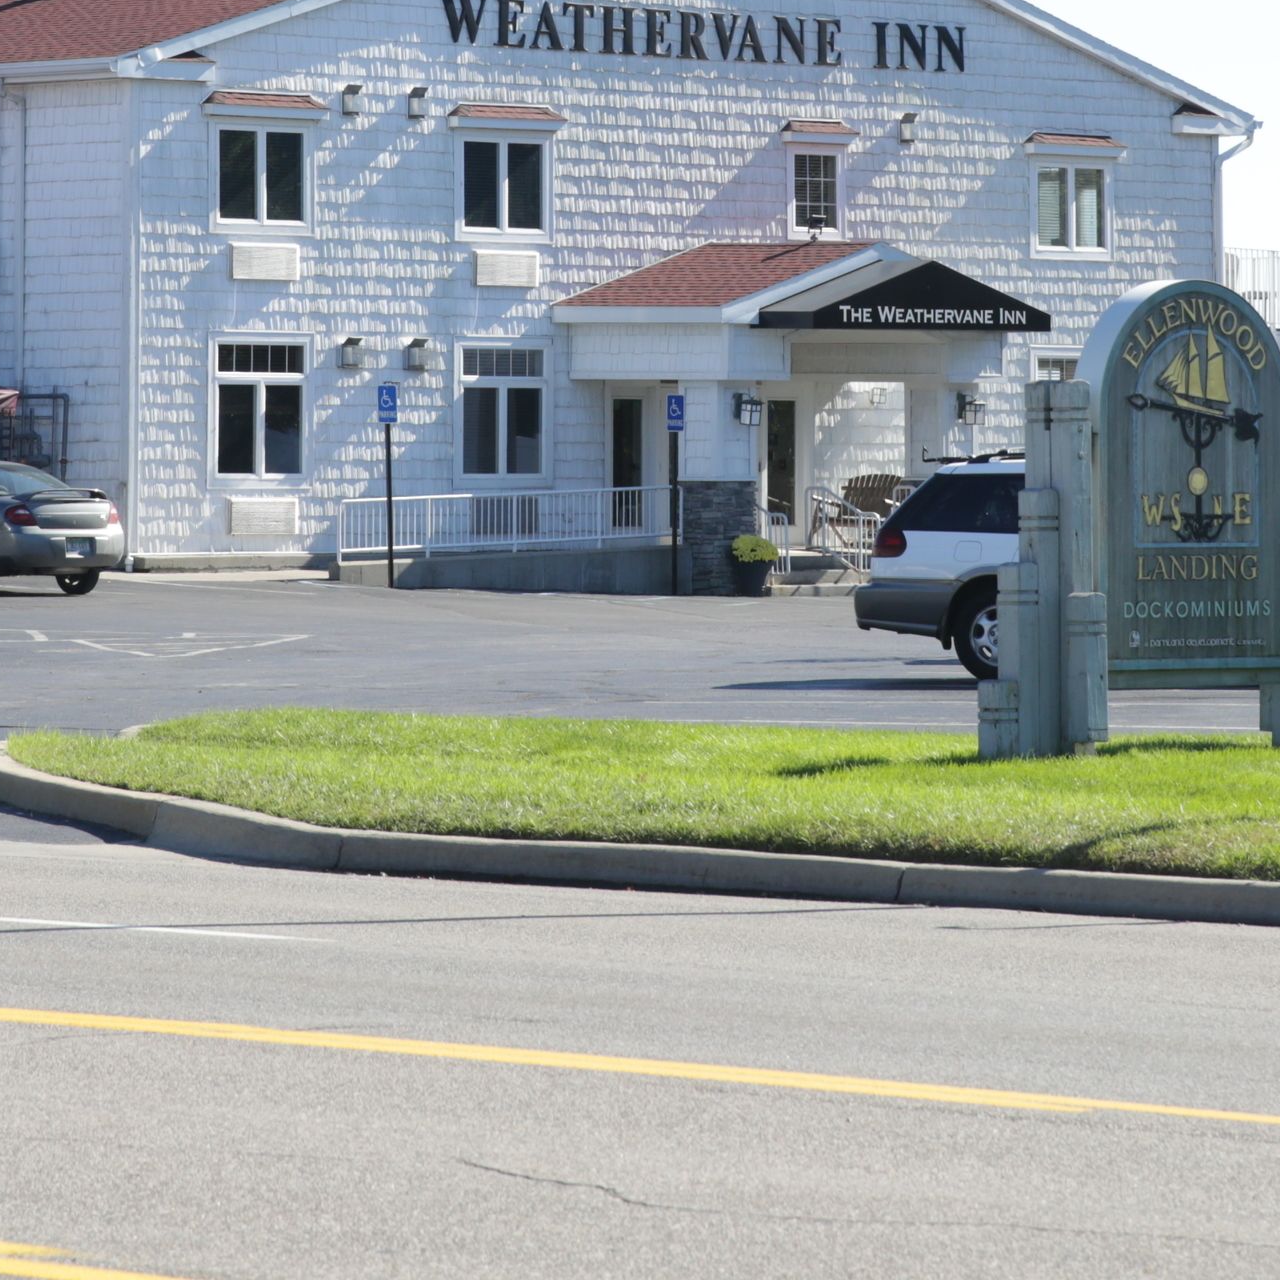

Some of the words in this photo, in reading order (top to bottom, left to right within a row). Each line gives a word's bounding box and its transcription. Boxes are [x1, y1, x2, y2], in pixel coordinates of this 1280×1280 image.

[871, 21, 967, 73] INN
[839, 305, 872, 323] THE
[878, 306, 994, 324] WEATHERVANE
[999, 308, 1027, 325] INN
[1122, 298, 1266, 371] ELLENWOOD
[1137, 554, 1258, 581] LANDING
[1123, 599, 1271, 619] DOCKOMINIUMS
